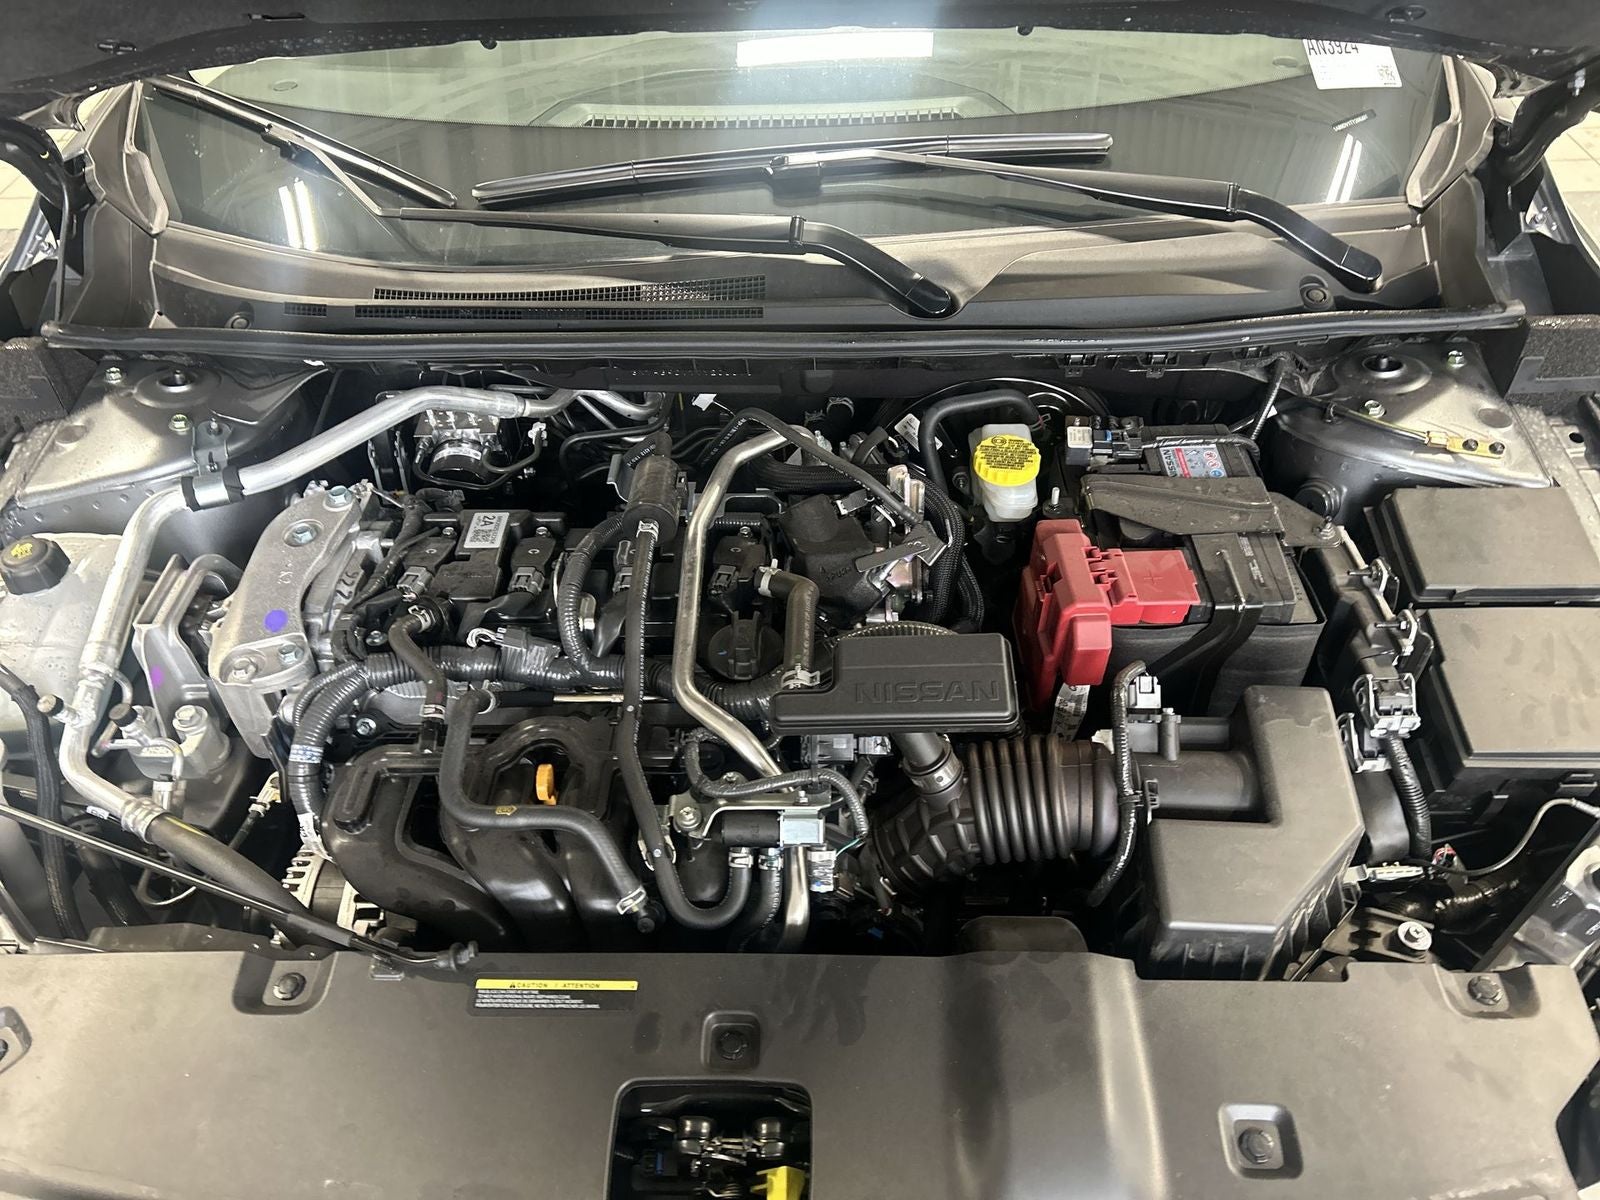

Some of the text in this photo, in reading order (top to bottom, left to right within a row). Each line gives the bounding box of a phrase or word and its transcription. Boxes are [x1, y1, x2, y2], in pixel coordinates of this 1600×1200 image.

[1307, 40, 1360, 56] AN3924
[481, 514, 497, 528] 2A
[854, 680, 1000, 704] NISSAN
